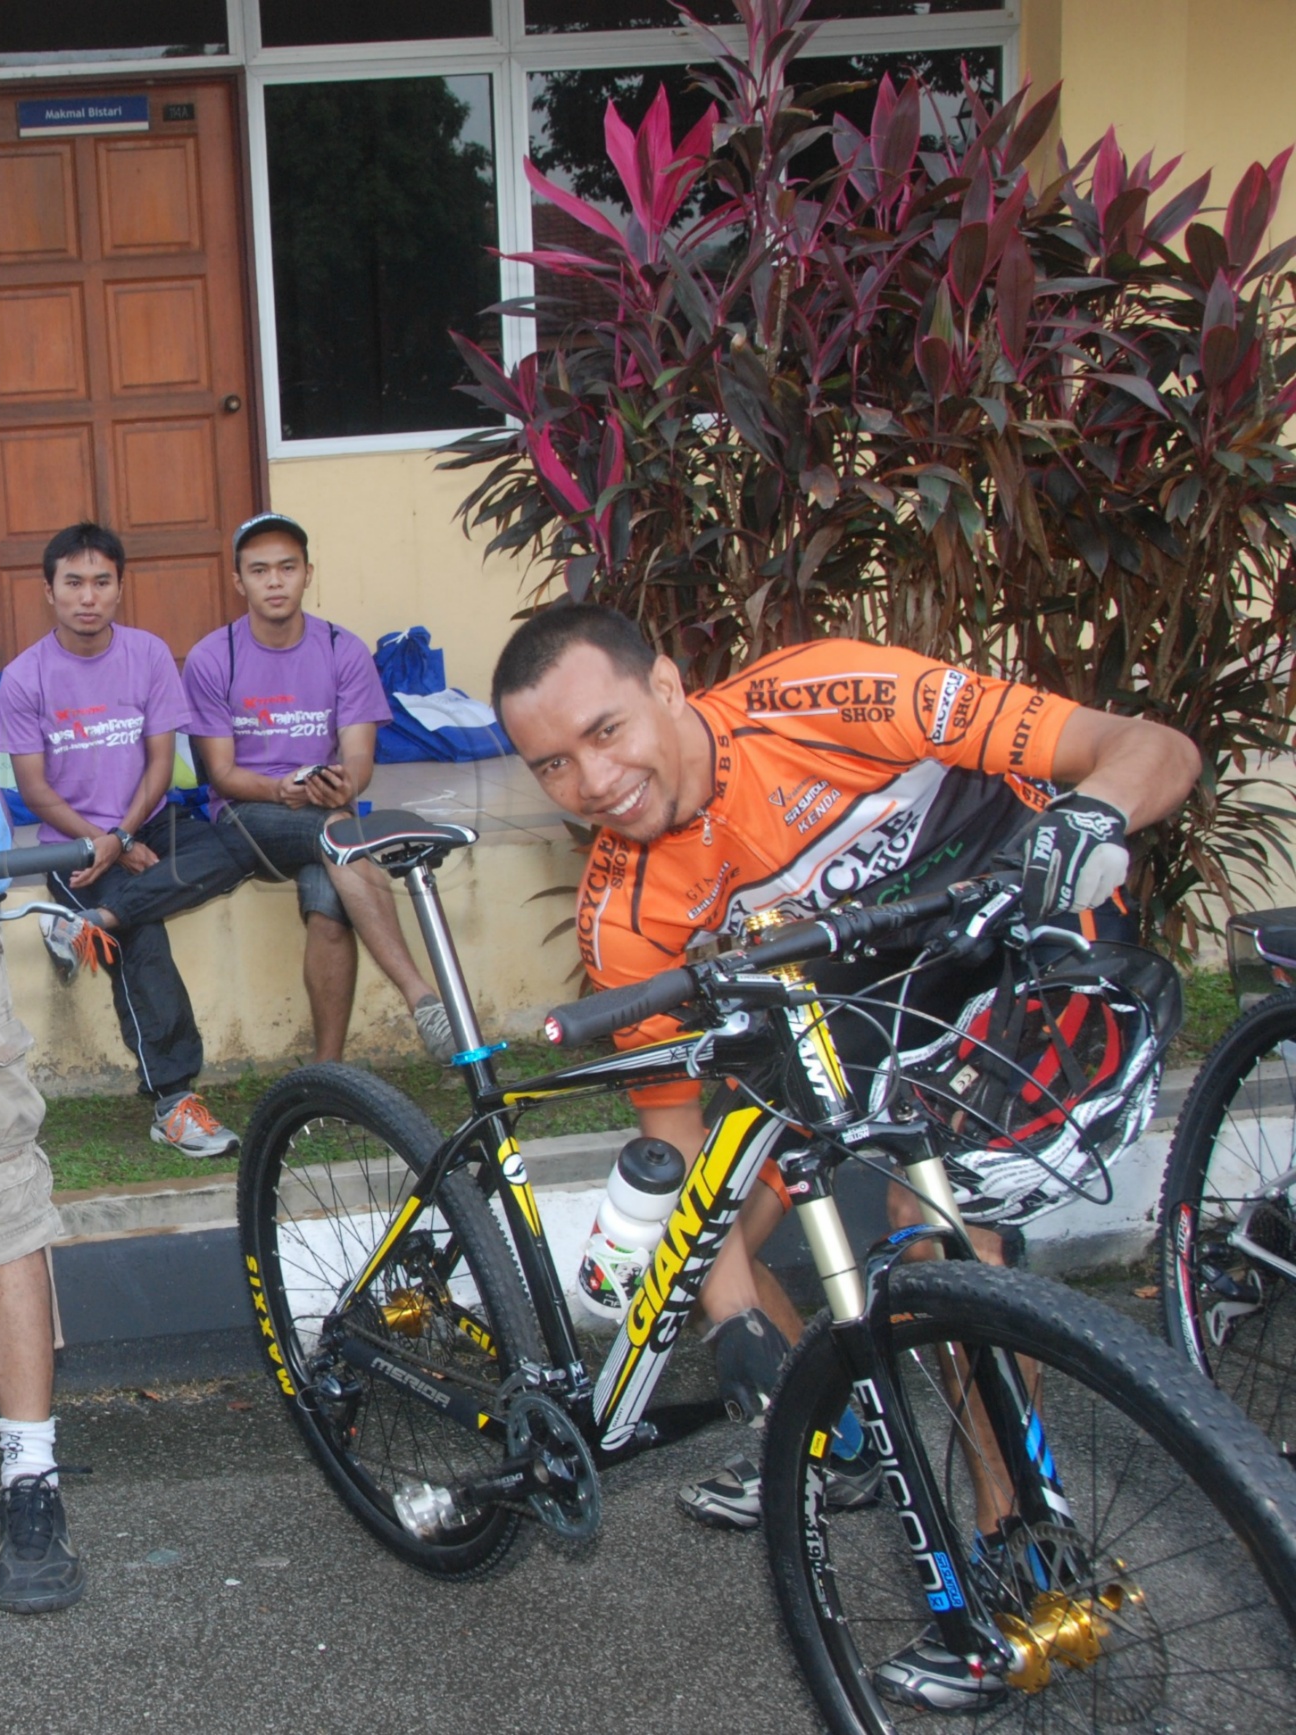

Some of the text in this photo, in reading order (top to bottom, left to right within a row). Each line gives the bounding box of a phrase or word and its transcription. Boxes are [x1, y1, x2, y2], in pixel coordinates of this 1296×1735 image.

[45, 105, 123, 120] Makmal Bistari
[744, 679, 897, 713] BICYCLE
[750, 677, 779, 690] MY
[922, 683, 937, 713] MY
[953, 683, 976, 729] SHOP
[841, 707, 896, 723] SHOP
[1008, 693, 1046, 766] NOT TO
[797, 788, 842, 835] KENDA
[1033, 826, 1058, 860] FOX
[577, 834, 617, 968] BICYCLE
[627, 1151, 714, 1349] GIANT
[1165, 1225, 1177, 1289] KEND
[246, 1254, 297, 1396] MAXXIS
[370, 1356, 452, 1409] MERIDA
[853, 1378, 944, 1592] EPICON
